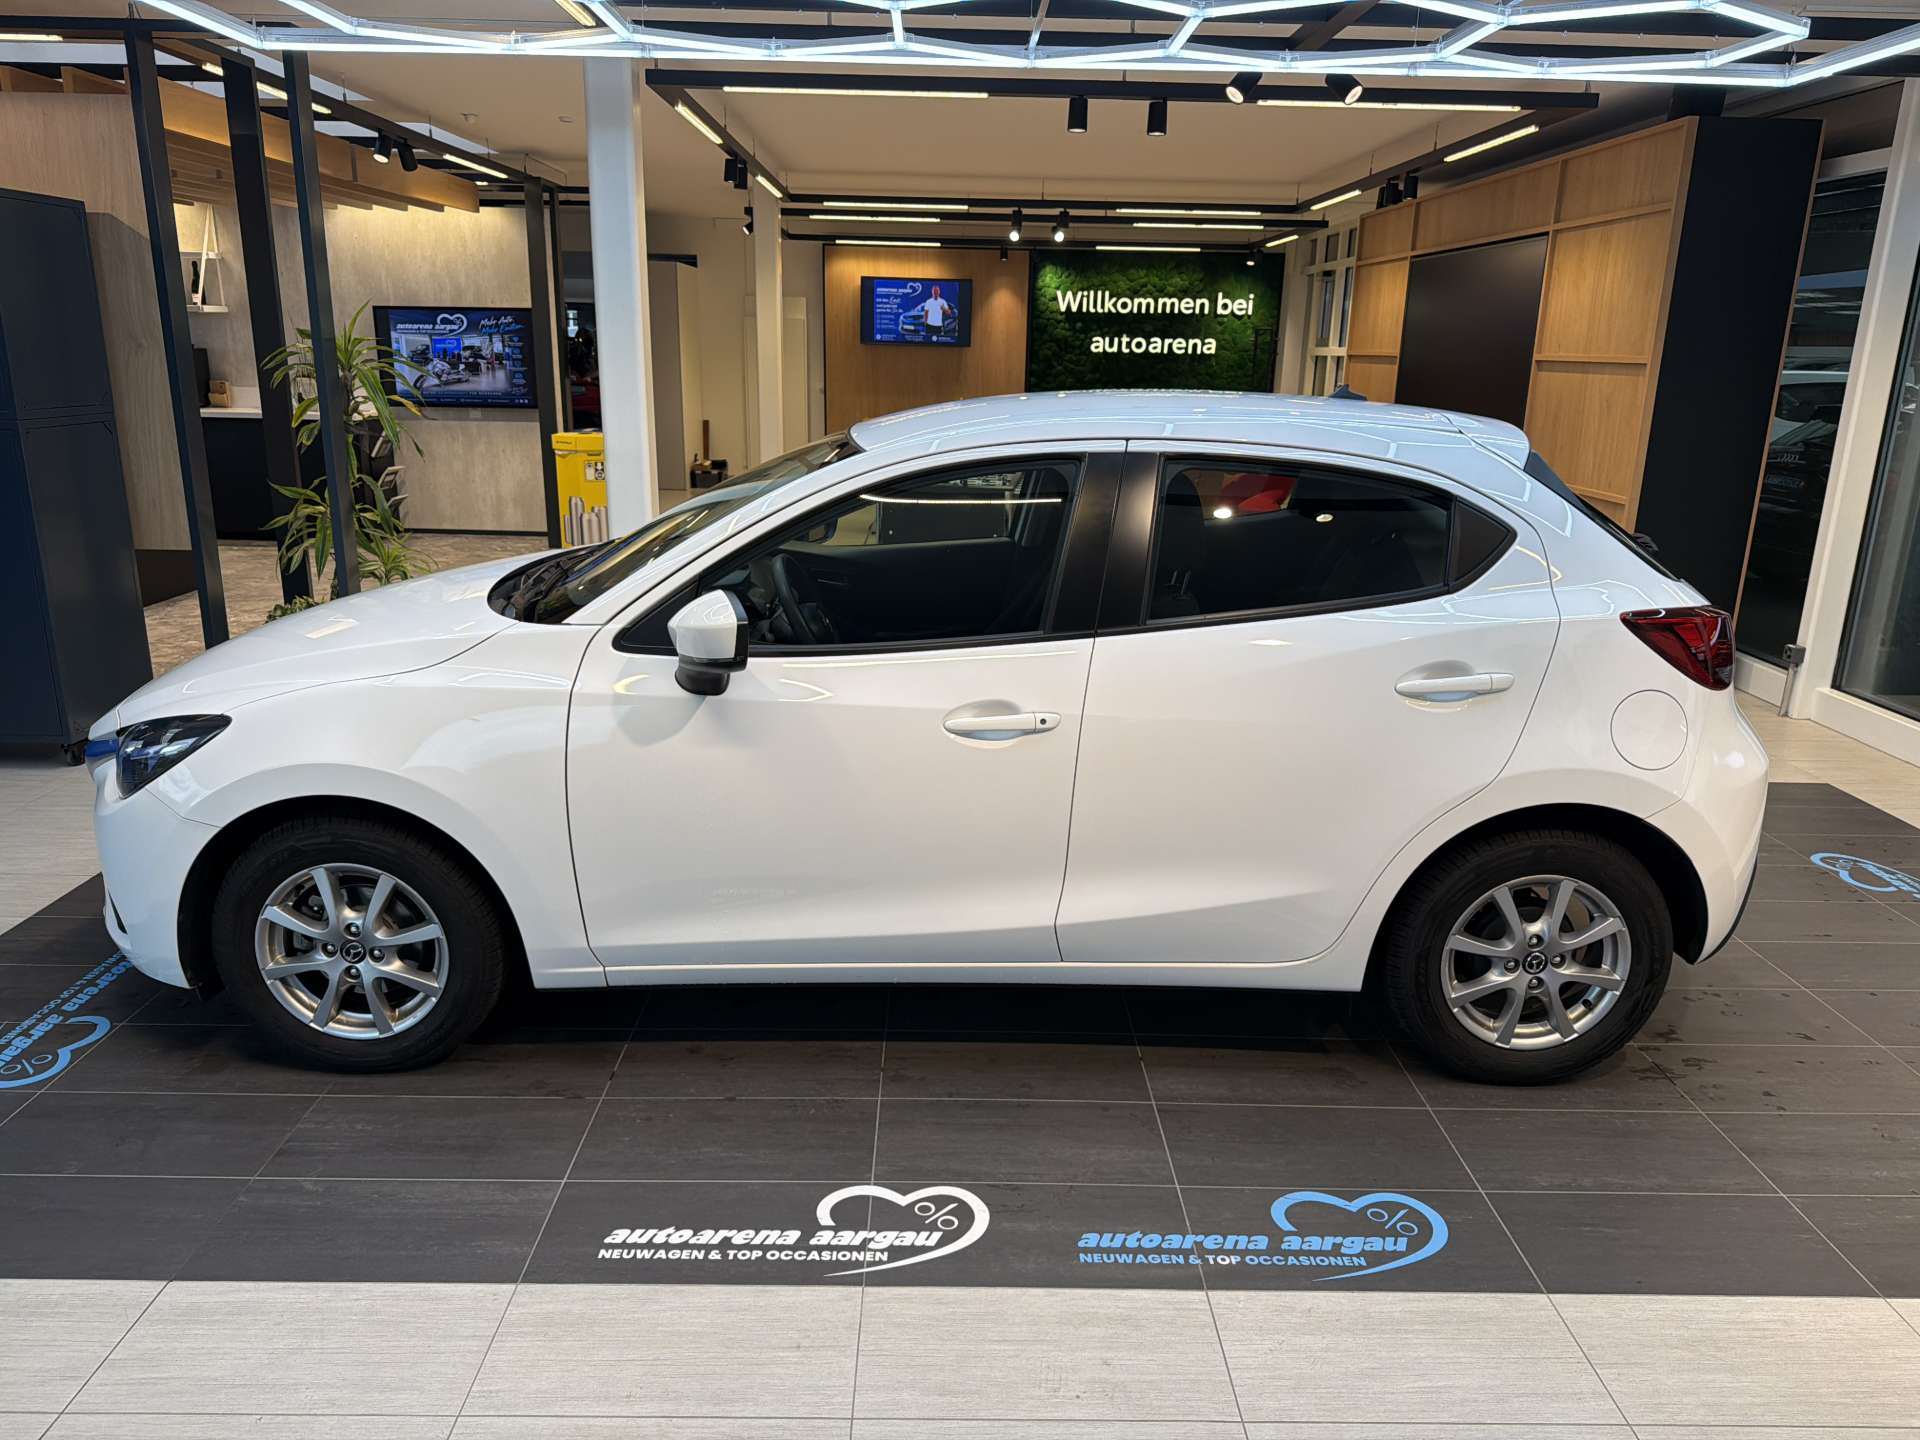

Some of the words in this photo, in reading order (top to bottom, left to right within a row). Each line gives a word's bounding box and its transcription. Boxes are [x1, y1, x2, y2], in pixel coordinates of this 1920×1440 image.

[1056, 290, 1209, 314] Willkommen
[1217, 292, 1255, 316] bei
[1090, 334, 1217, 355] autoarena
[603, 1226, 802, 1246] autoarena
[809, 1229, 943, 1249] aargau
[1078, 1231, 1269, 1250] autoarena
[1281, 1234, 1408, 1254] aargau
[597, 1248, 705, 1260] NEUWAGEN
[708, 1249, 722, 1260] &
[727, 1249, 763, 1261] TOP
[766, 1249, 889, 1262] OCCASIONEN
[1079, 1252, 1185, 1265] NEUWAGEN
[1188, 1253, 1202, 1265] &
[1205, 1254, 1242, 1266] TOP
[1245, 1255, 1368, 1267] OCCASIONEN
